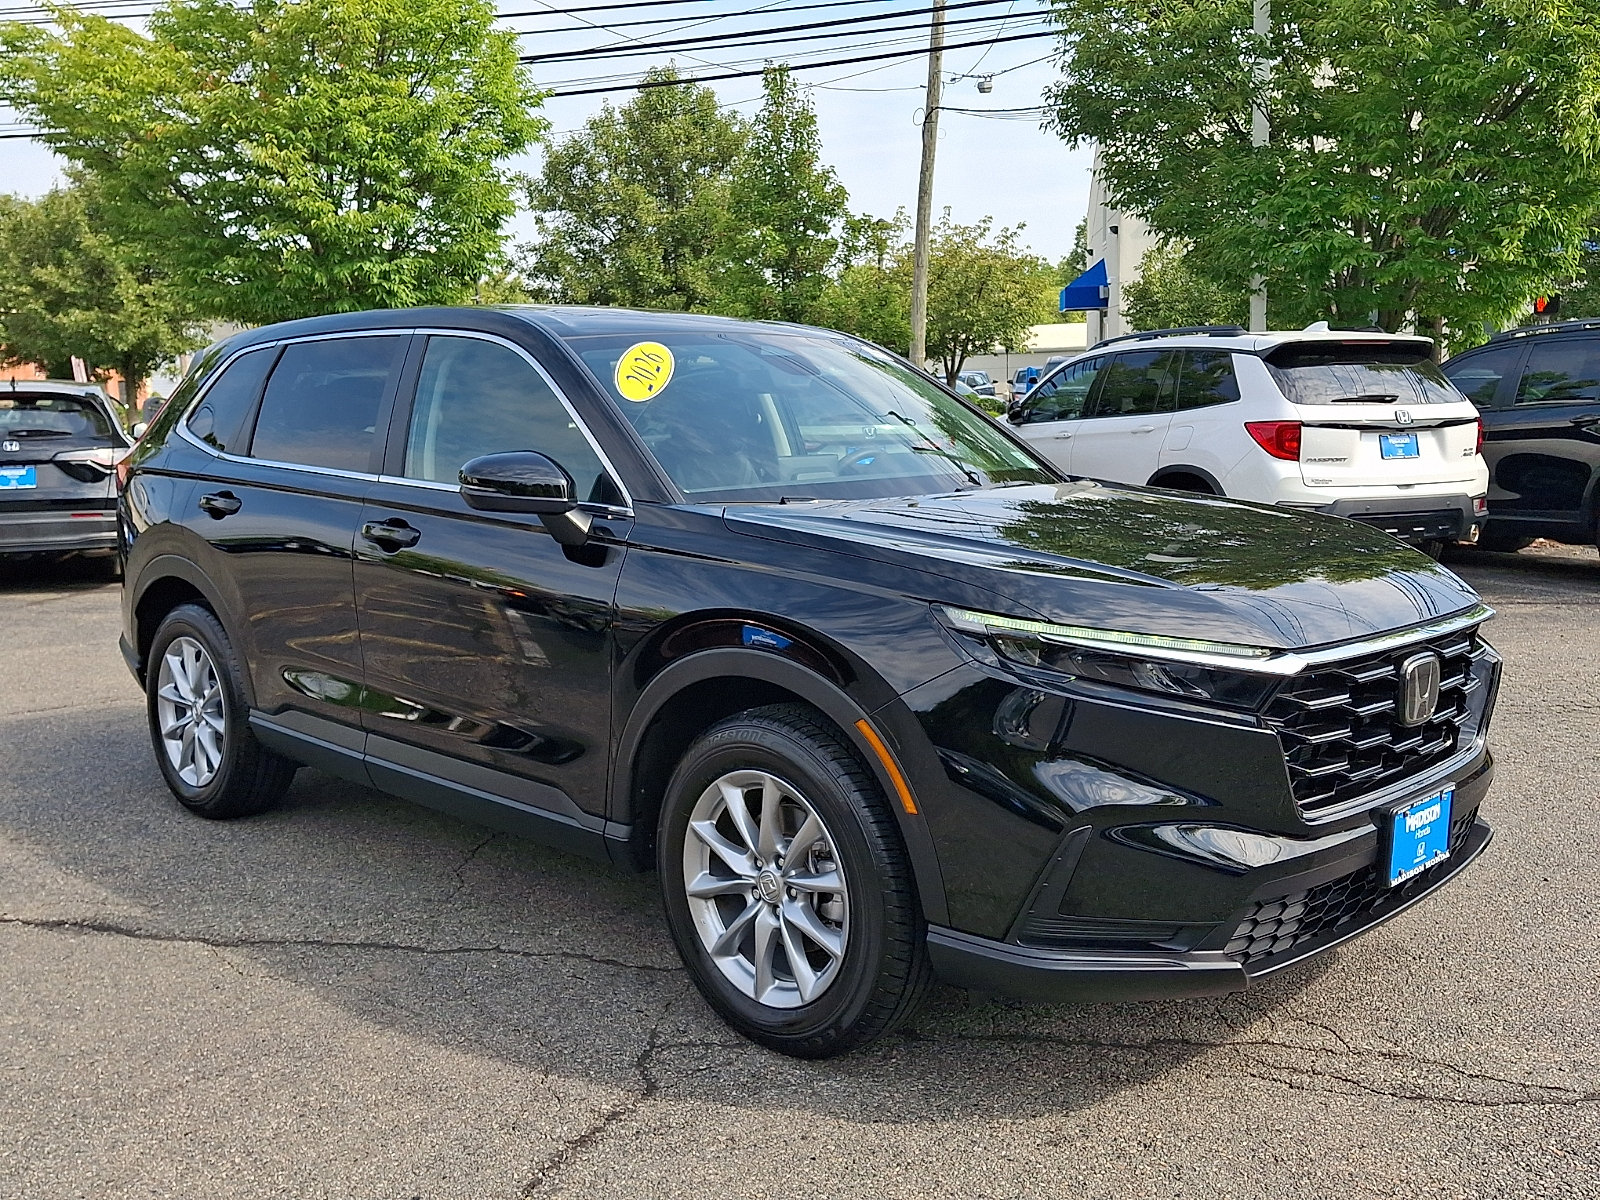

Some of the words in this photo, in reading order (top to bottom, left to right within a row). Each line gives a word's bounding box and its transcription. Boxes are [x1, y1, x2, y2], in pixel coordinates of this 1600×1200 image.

[626, 348, 664, 392] 2026
[688, 729, 769, 761] GESTONE
[1405, 803, 1441, 834] MADISON
[1414, 825, 1431, 840] Honda
[1390, 864, 1425, 888] MADISON
[1425, 849, 1451, 869] HONDA
